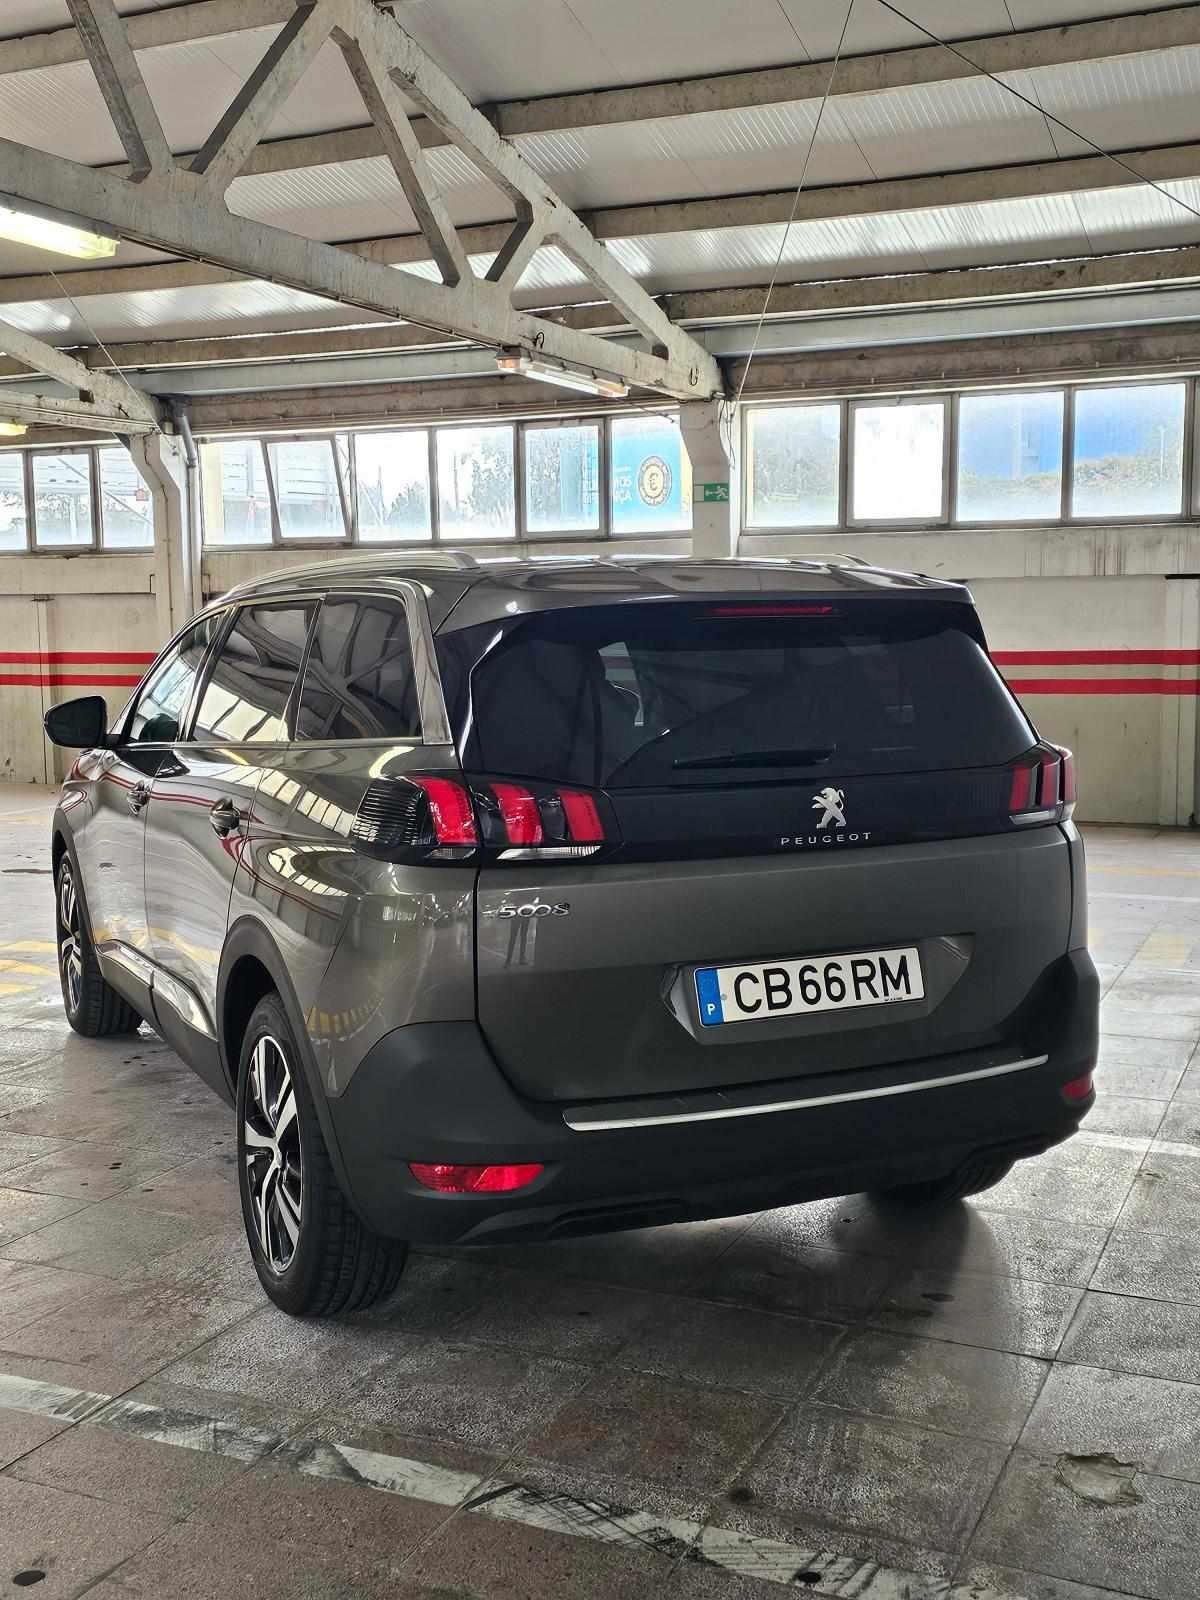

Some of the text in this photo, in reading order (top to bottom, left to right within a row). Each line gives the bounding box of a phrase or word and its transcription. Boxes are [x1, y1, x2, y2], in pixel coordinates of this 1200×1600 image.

[780, 832, 871, 846] PEUGEOT
[498, 903, 569, 918] 5008
[706, 1003, 716, 1016] P
